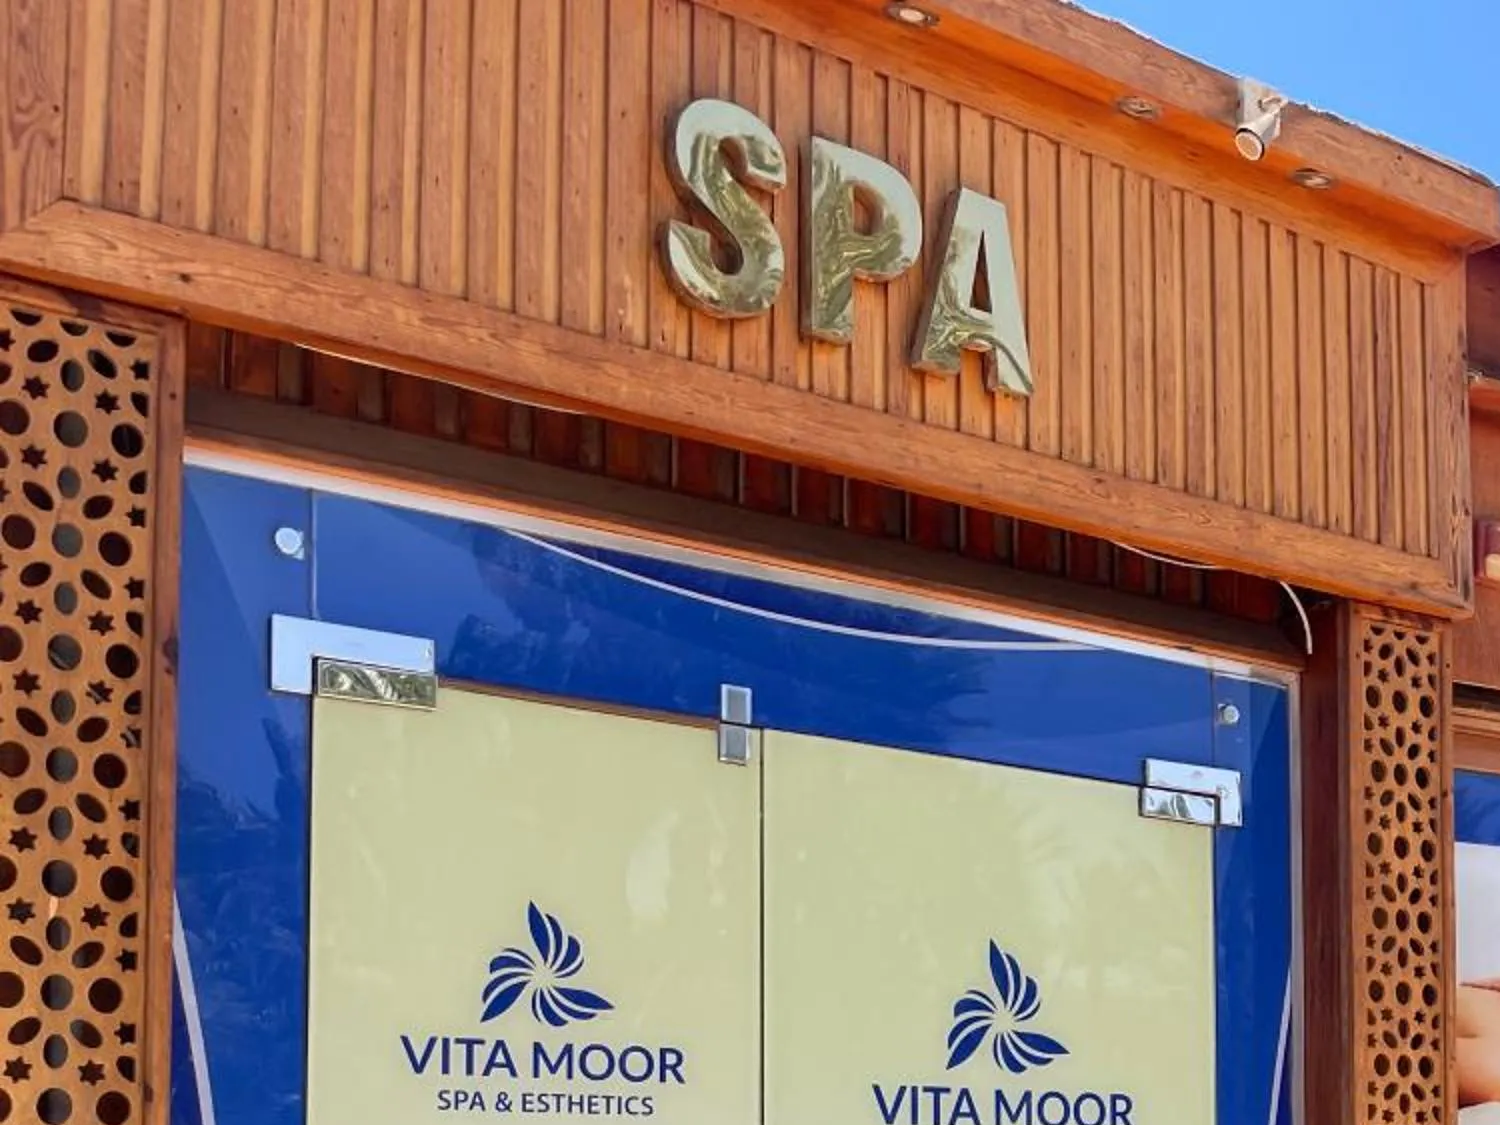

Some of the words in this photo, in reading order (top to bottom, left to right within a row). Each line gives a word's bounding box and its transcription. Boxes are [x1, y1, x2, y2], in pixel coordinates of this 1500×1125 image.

[656, 98, 1034, 398] SPA
[400, 1034, 518, 1079] VITA
[531, 1040, 686, 1085] MOOR
[437, 1089, 486, 1112] SPA
[495, 1091, 513, 1113] &
[521, 1092, 654, 1116] ESTHETICS
